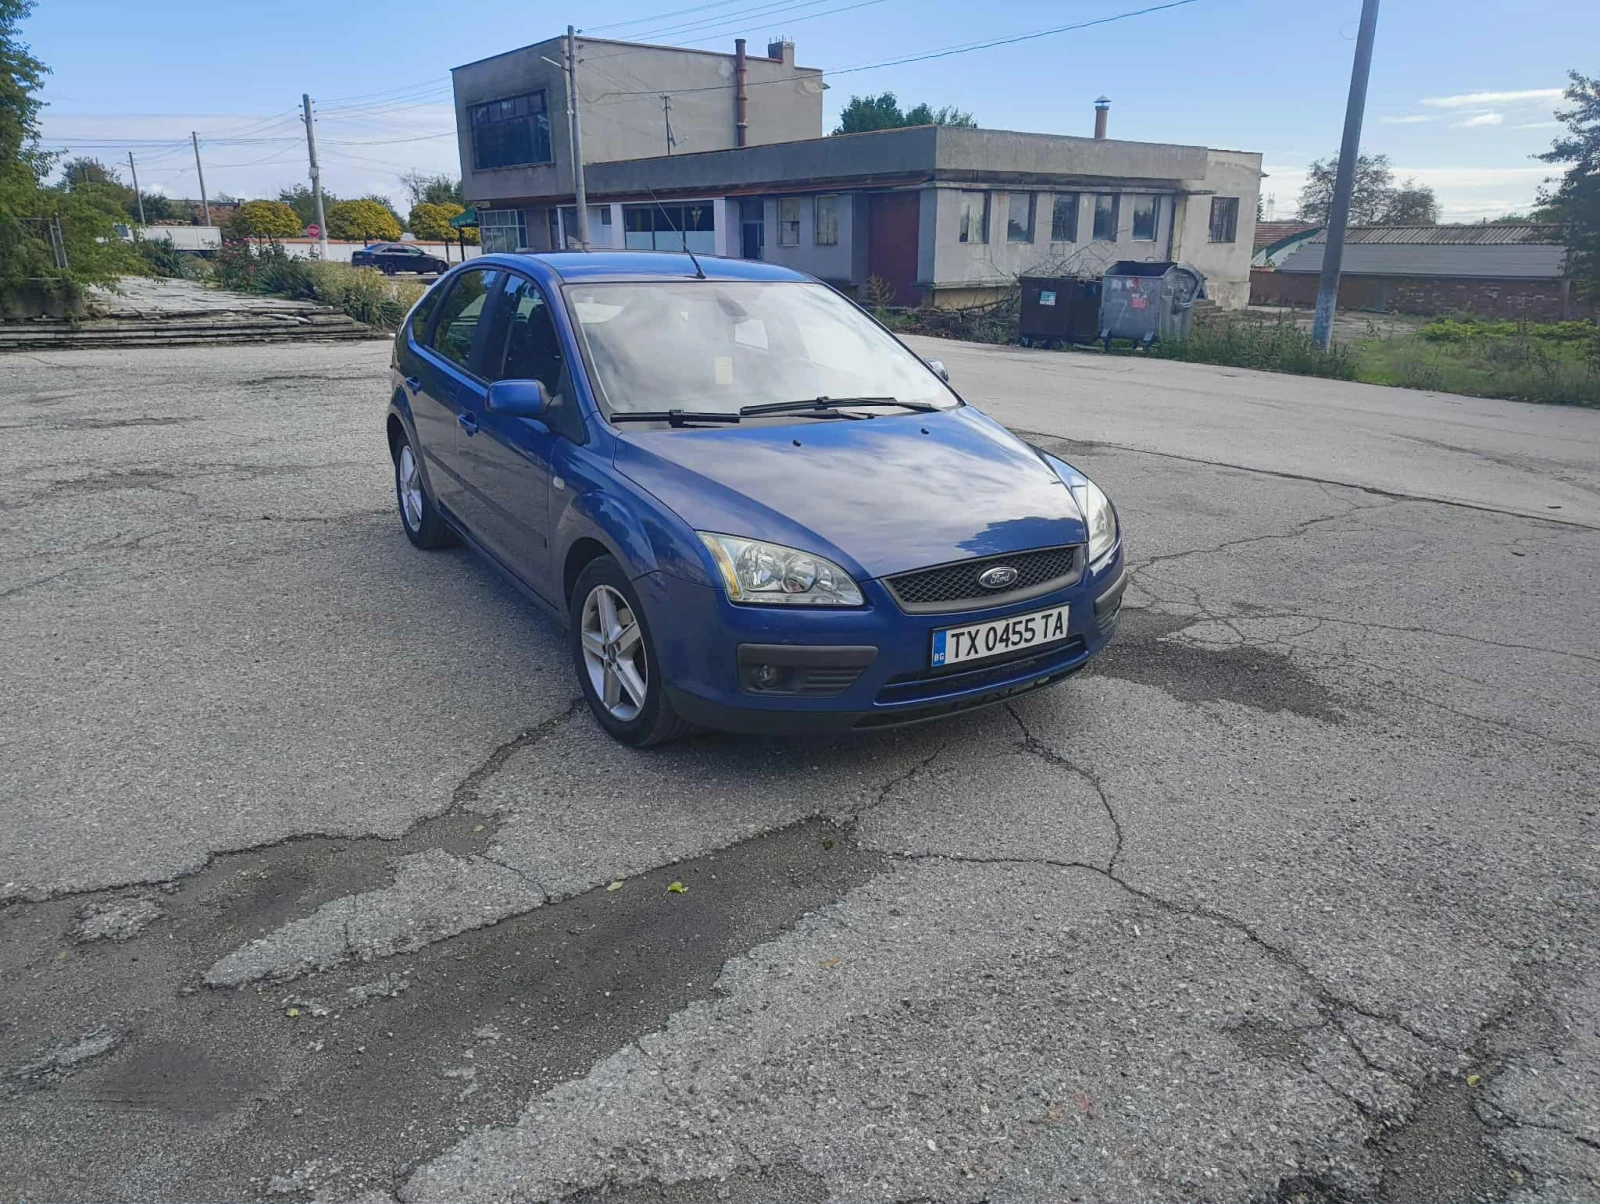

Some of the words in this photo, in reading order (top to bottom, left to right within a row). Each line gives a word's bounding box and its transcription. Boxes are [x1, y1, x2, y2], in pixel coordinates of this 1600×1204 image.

[990, 571, 1010, 584] Ford
[951, 630, 980, 658] TX
[985, 618, 1036, 651] 0455
[1041, 611, 1064, 638] TA
[934, 653, 945, 662] BG
